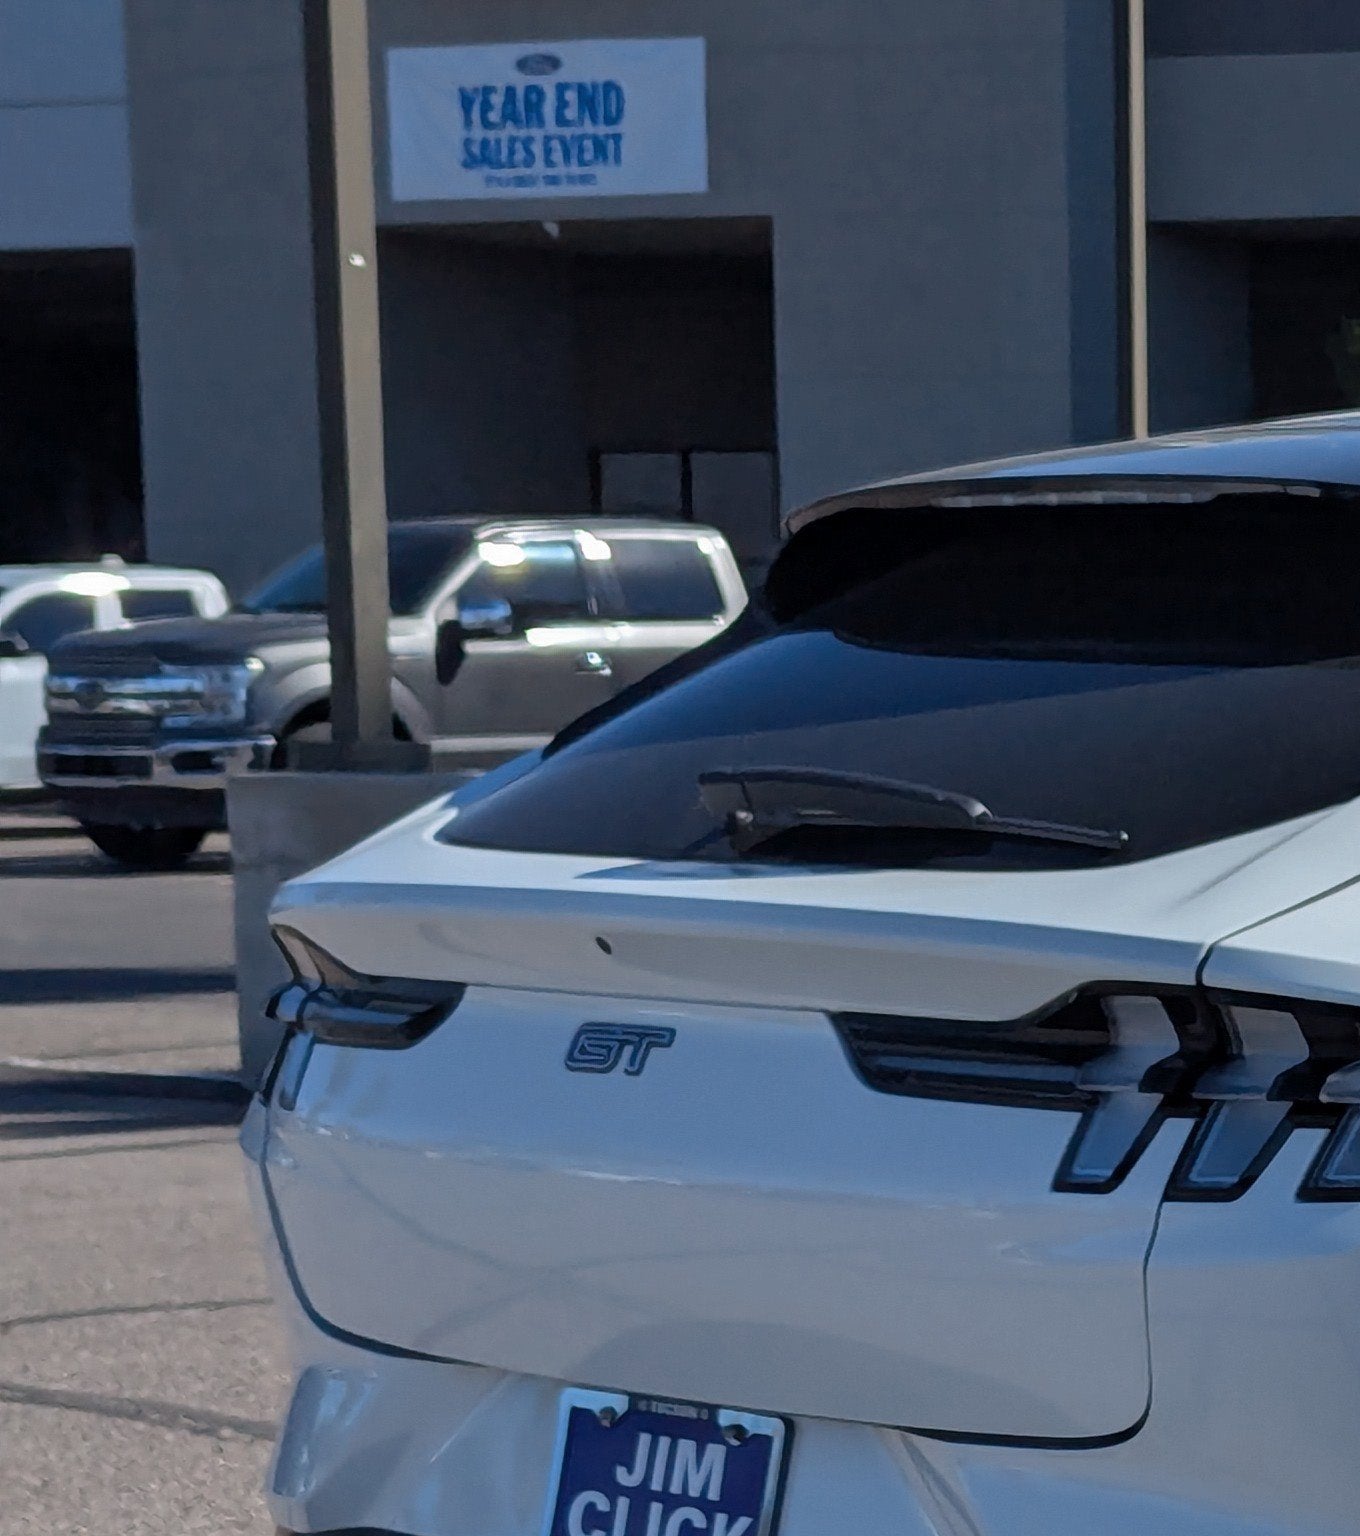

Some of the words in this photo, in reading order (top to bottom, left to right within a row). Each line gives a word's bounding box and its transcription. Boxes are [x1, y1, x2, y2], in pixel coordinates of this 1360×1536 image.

[458, 84, 546, 131] YEAR
[554, 80, 625, 128] END
[461, 135, 536, 169] SALES
[543, 133, 623, 168] EVENT
[564, 1022, 676, 1076] GT
[616, 1432, 727, 1501] JIM
